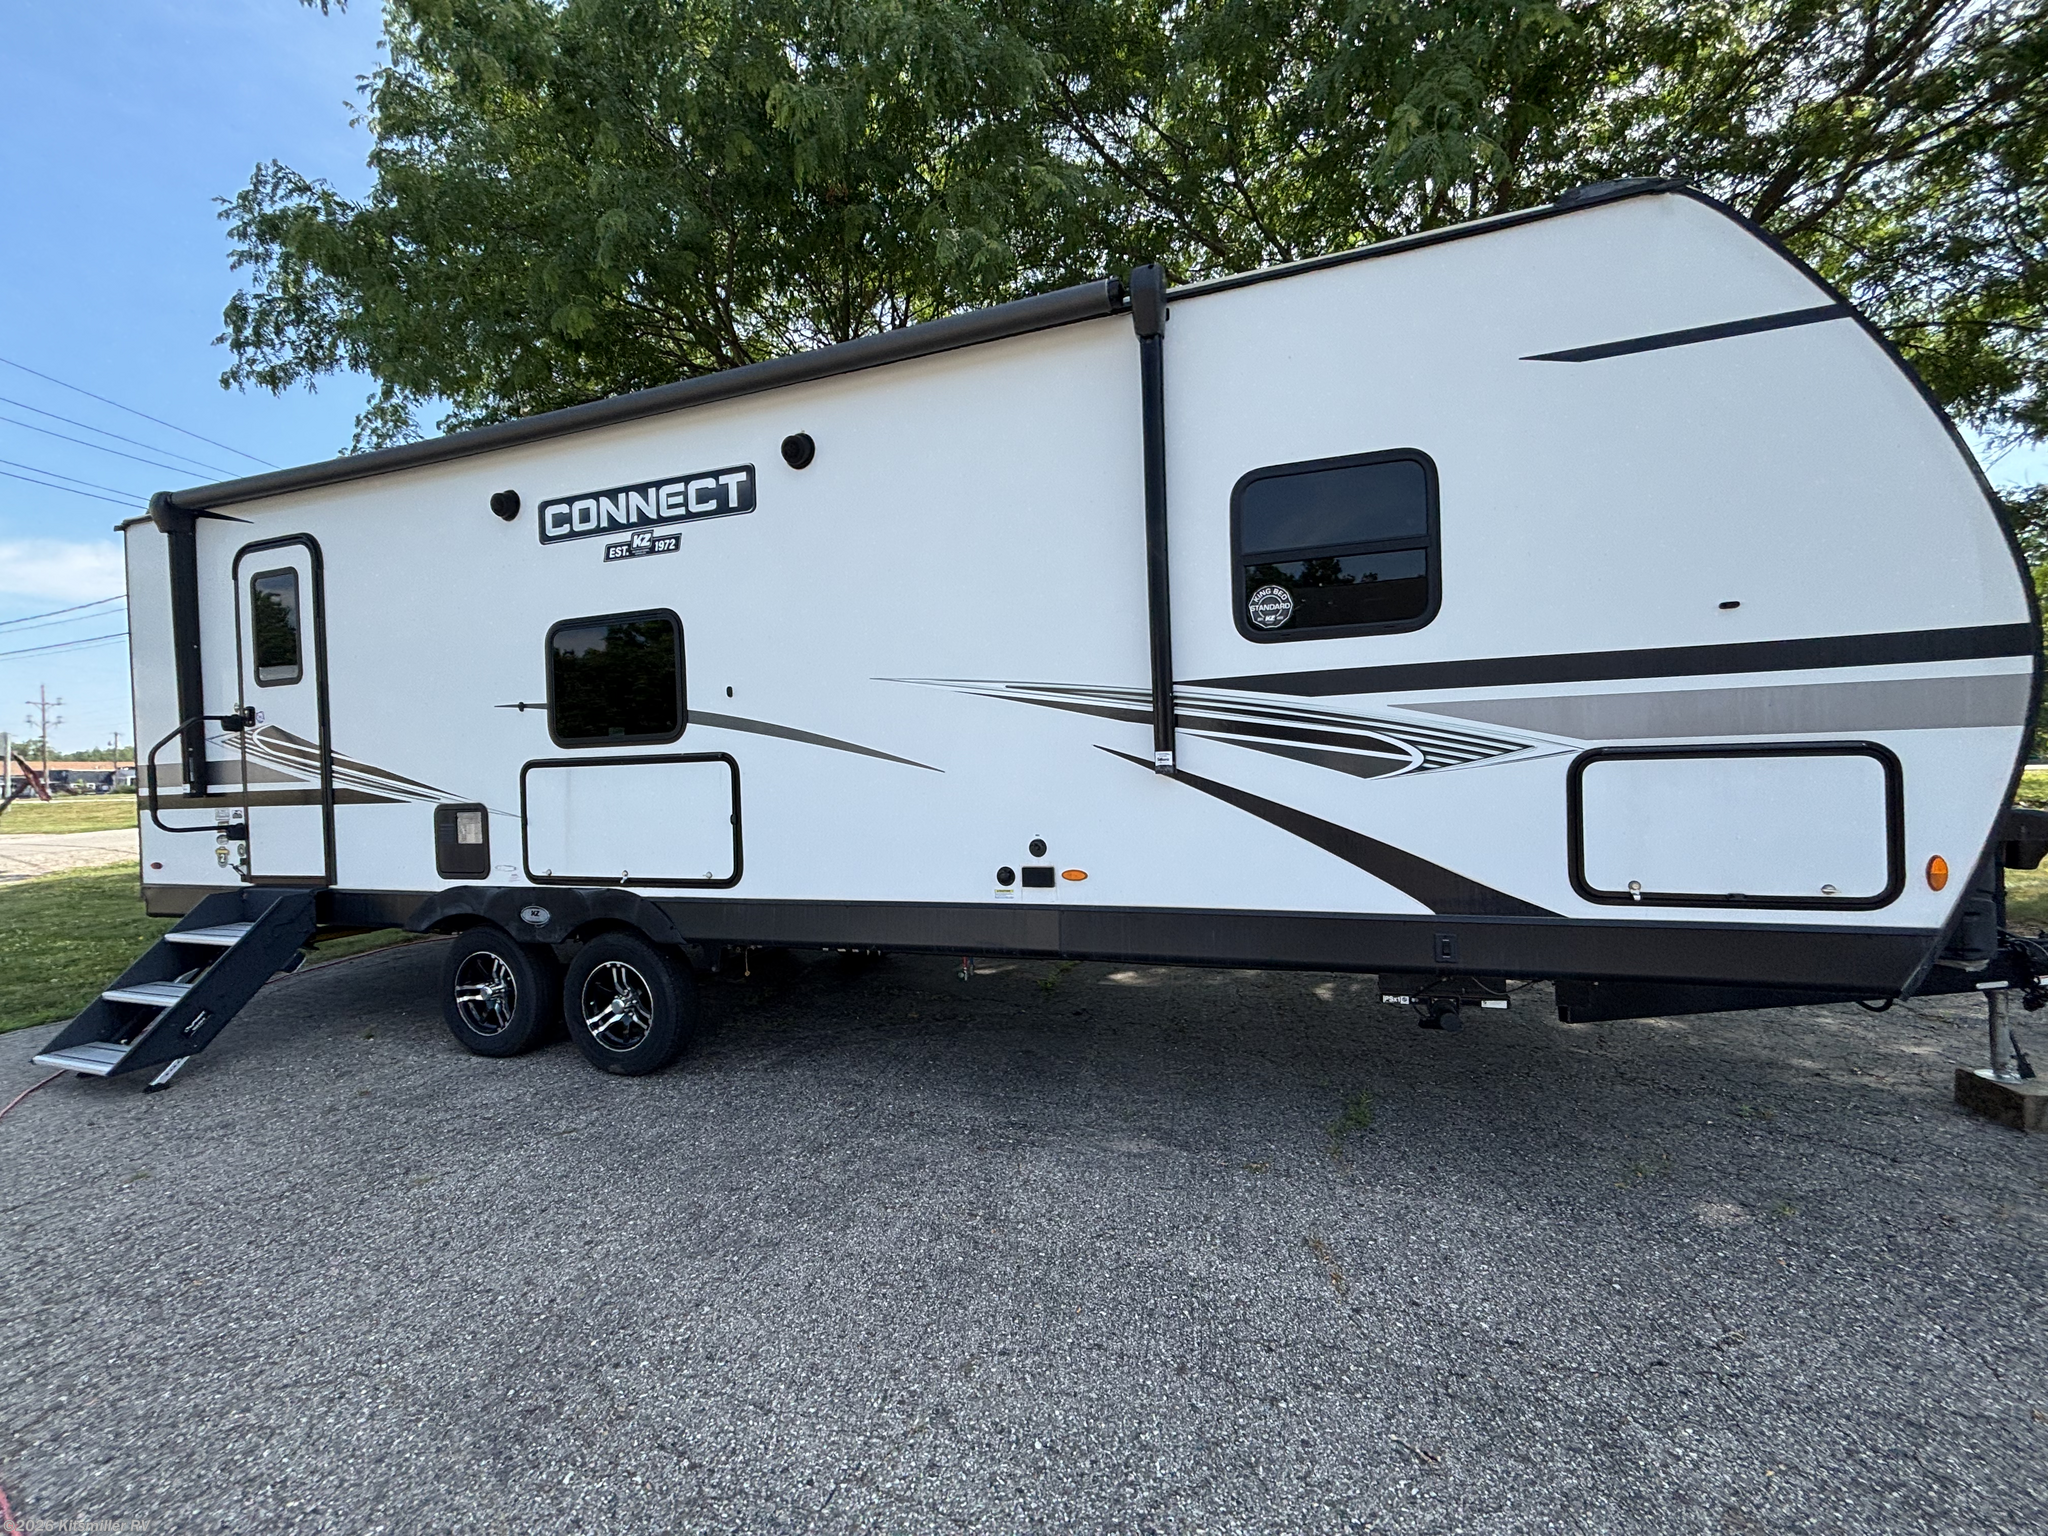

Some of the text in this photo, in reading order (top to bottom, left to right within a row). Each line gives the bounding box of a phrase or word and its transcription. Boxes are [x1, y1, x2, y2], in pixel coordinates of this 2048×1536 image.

[544, 470, 747, 537] CONNECT
[608, 545, 630, 559] EST.
[632, 533, 652, 548] KZ
[654, 538, 676, 552] 1972
[1253, 587, 1288, 603] KING BED
[1250, 602, 1291, 612] STANDARD
